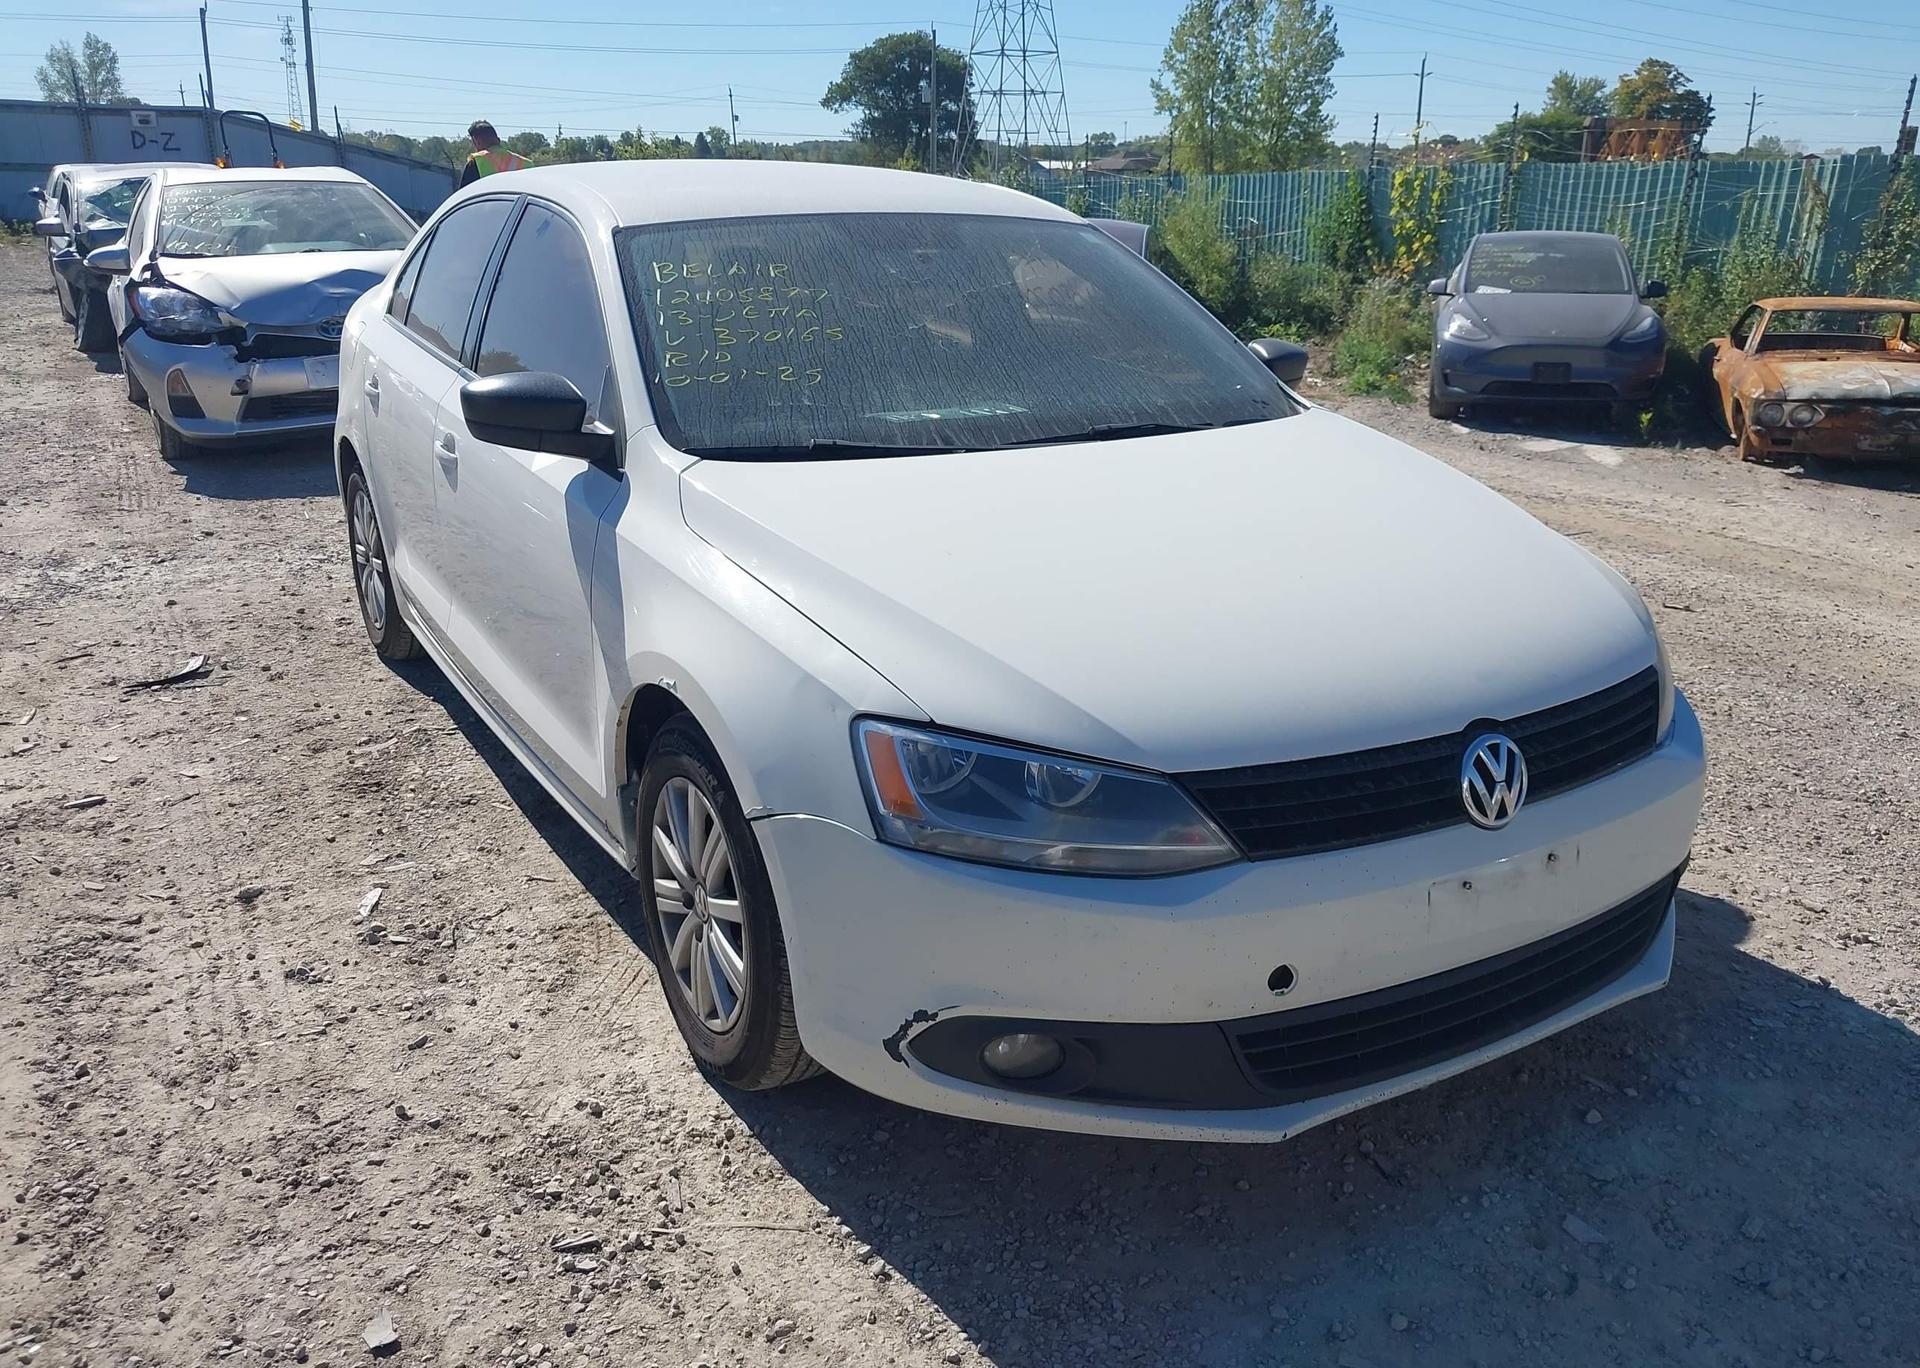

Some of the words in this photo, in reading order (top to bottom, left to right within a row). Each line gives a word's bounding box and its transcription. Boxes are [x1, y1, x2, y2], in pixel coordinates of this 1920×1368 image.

[130, 130, 182, 152] D-Z
[652, 261, 788, 284] BELAIR
[1462, 735, 1528, 826] VW
